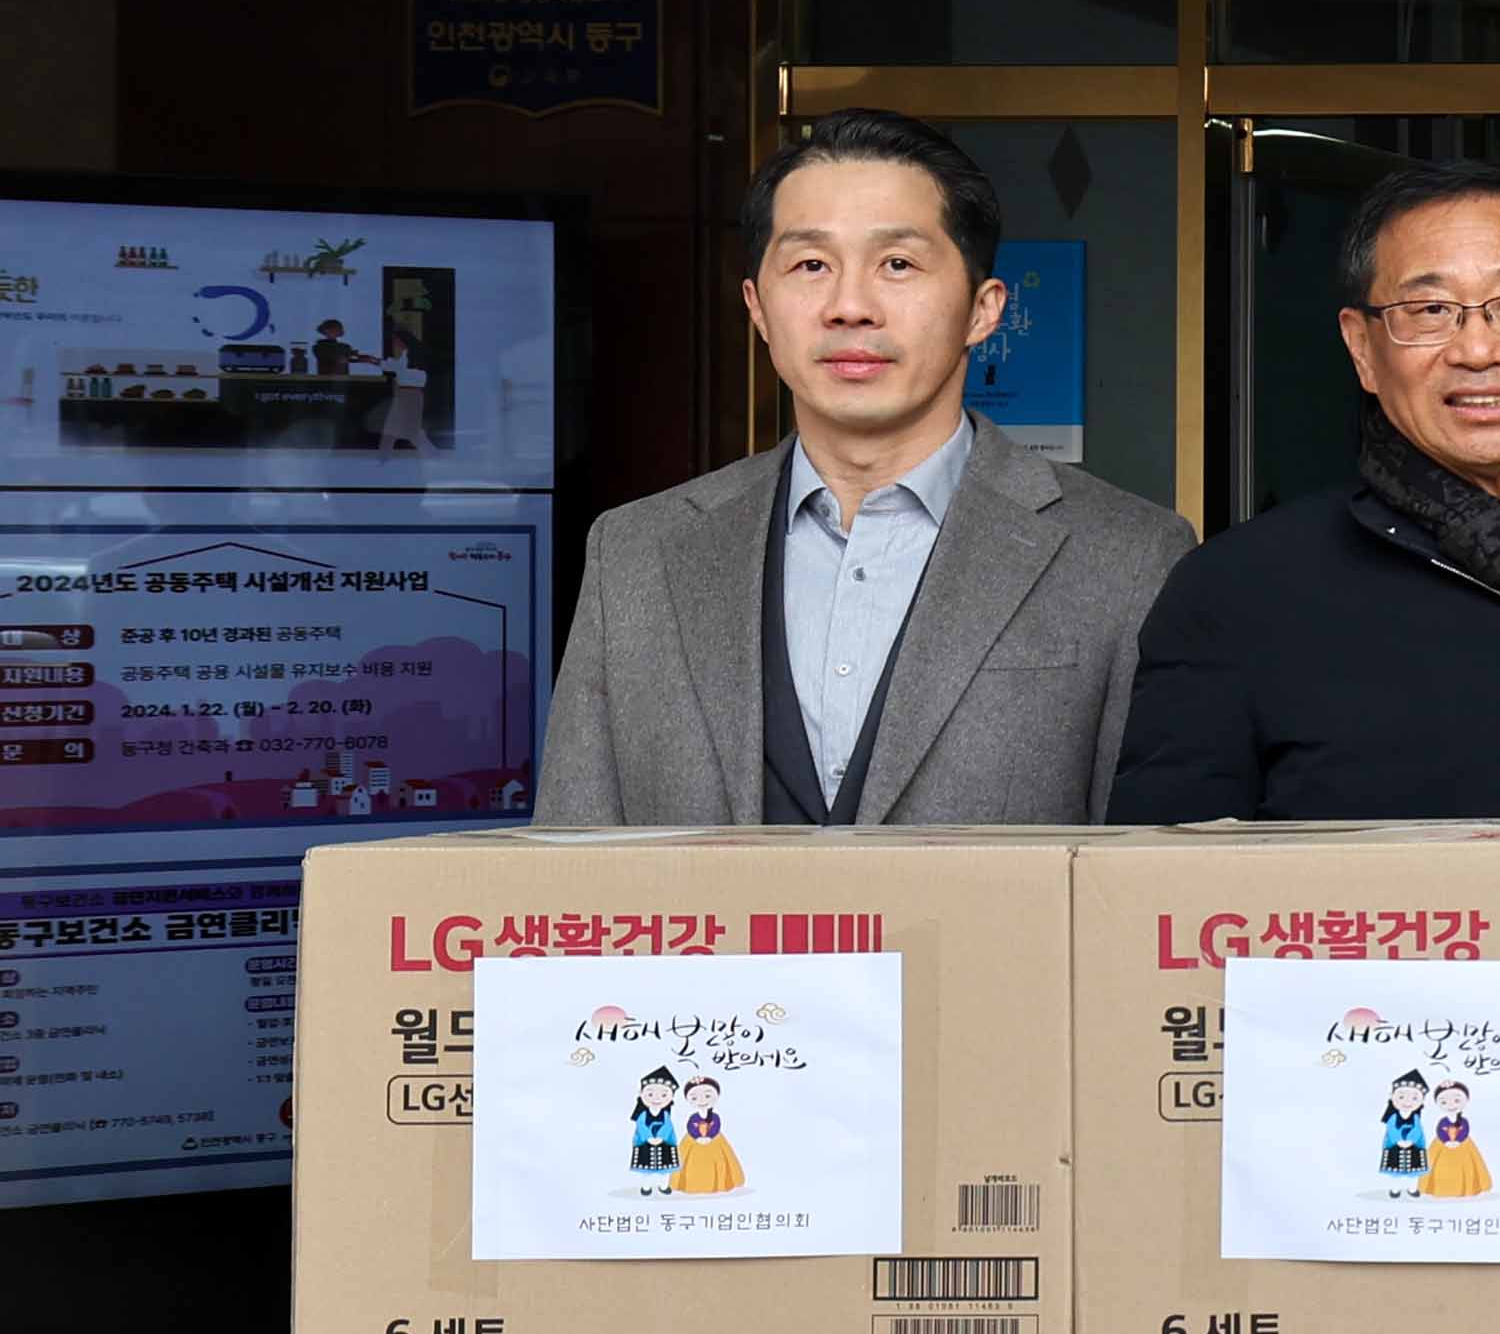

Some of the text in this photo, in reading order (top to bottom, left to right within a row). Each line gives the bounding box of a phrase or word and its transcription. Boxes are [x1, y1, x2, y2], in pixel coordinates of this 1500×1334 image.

[585, 21, 643, 55] 동구
[16, 570, 429, 593] 2024년도 공동주택 시설개선 지원사업
[121, 625, 342, 644] 준공 후 10년 경과된 공동주택
[120, 666, 191, 682] 공동주택
[291, 662, 358, 678] 유지보수
[400, 660, 433, 676] 지원
[121, 704, 176, 718] 2024.
[201, 703, 228, 716] 22.
[309, 700, 336, 714] 20.
[122, 740, 173, 757] 동구청
[0, 917, 152, 950] 동구보건소
[1157, 909, 1490, 971] LG생활건강
[574, 1015, 661, 1042] 새해
[1326, 1021, 1413, 1047] 새해
[710, 1046, 808, 1071] 받으세요
[579, 1210, 811, 1234] 사단법인 동구기업인협의회
[1327, 1216, 1400, 1237] 사단법인
